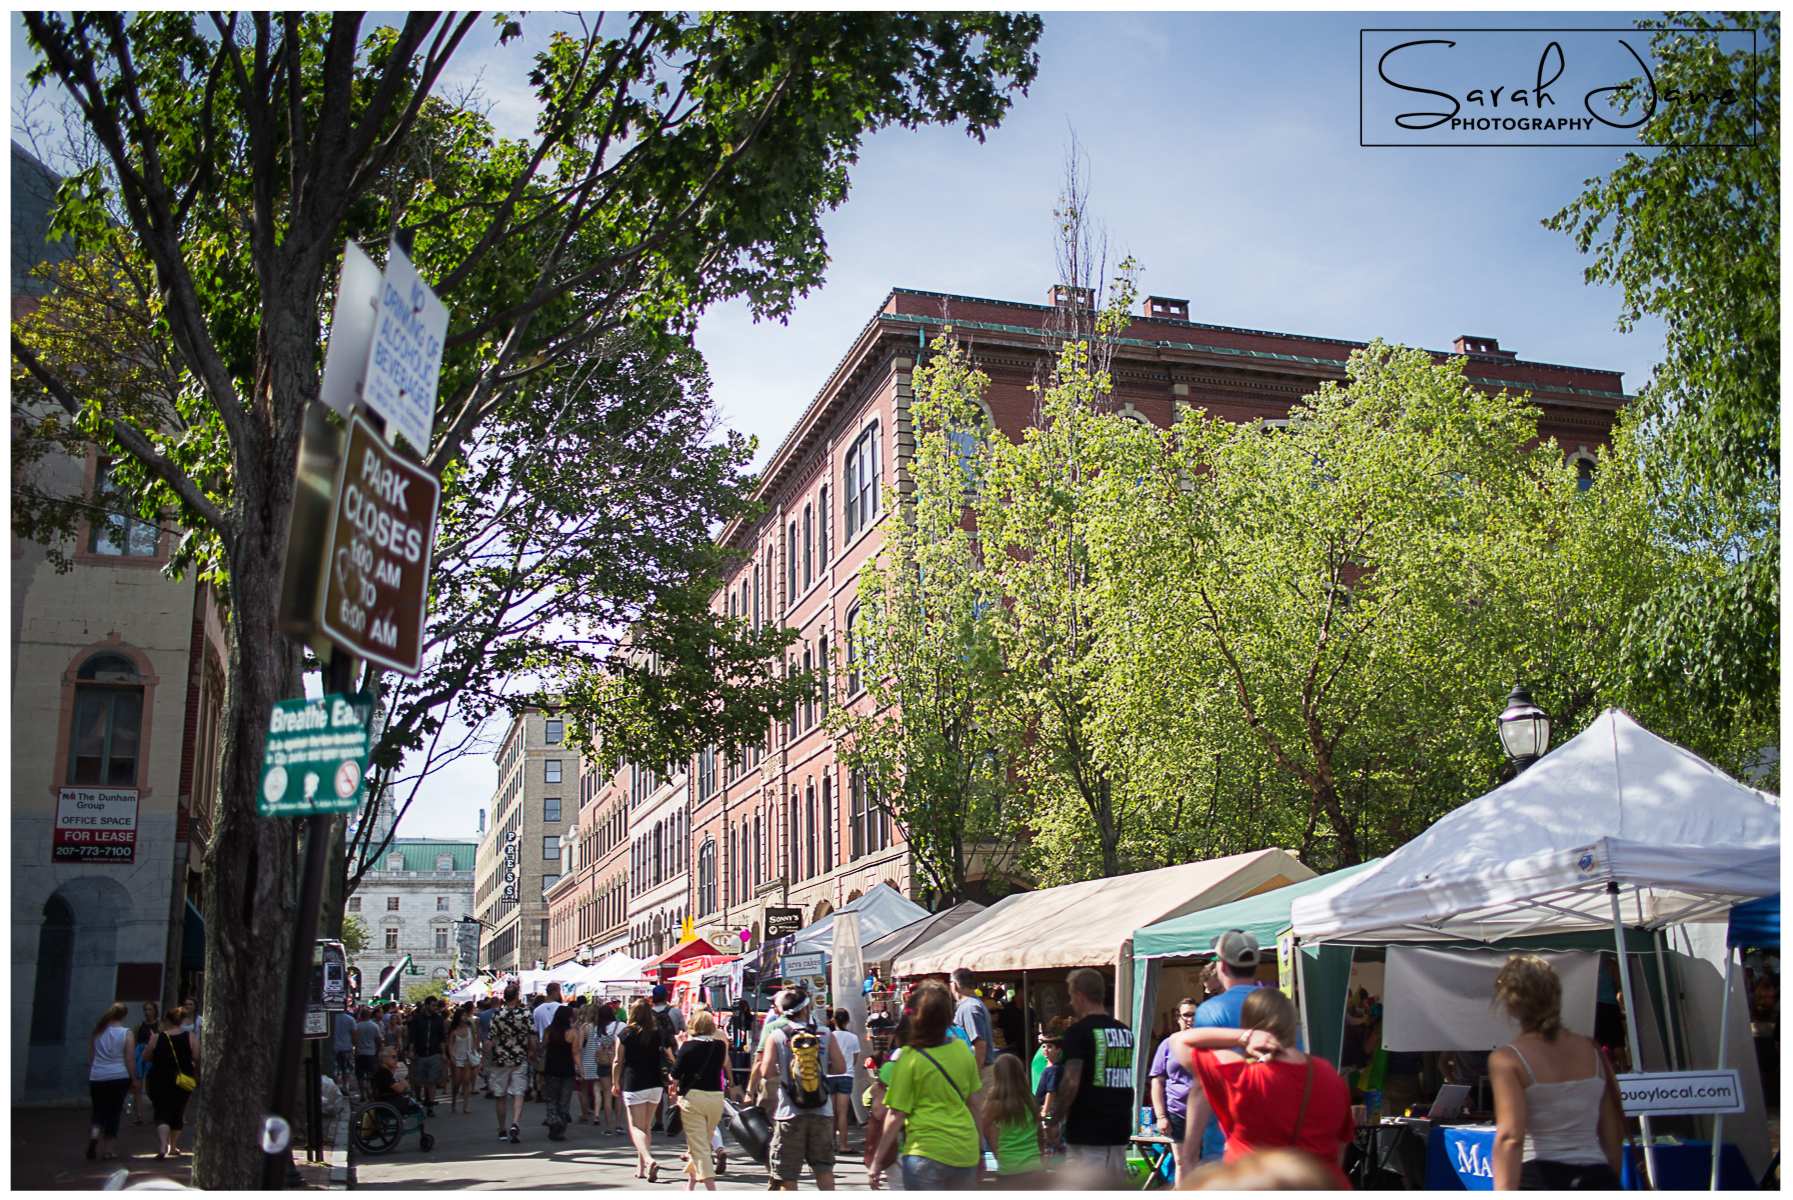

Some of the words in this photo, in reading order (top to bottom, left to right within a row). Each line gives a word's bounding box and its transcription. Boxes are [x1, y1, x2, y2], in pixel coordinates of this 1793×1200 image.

[383, 281, 426, 347] DRINKING
[427, 334, 440, 359] OF
[381, 315, 434, 388] ALCOHOLIC
[374, 340, 431, 417] BEVERAGES
[361, 447, 411, 512] PARK
[344, 484, 422, 563] CLOSES
[375, 559, 401, 589] AM
[359, 577, 377, 607] TO
[369, 618, 398, 648] AM
[270, 703, 329, 733] Breathe
[77, 801, 105, 810] Group
[99, 794, 136, 802] Dunham
[62, 816, 97, 824] OFFICE
[100, 817, 132, 825] SPACE
[56, 846, 131, 856] 207-773-7100
[64, 831, 90, 841] FOR
[95, 832, 135, 842] LEASE
[504, 831, 516, 896] PRESS
[803, 957, 822, 967] cakes
[1107, 1048, 1132, 1068] WRA
[1105, 1068, 1132, 1087] THIN
[1455, 1141, 1494, 1177] Ma
